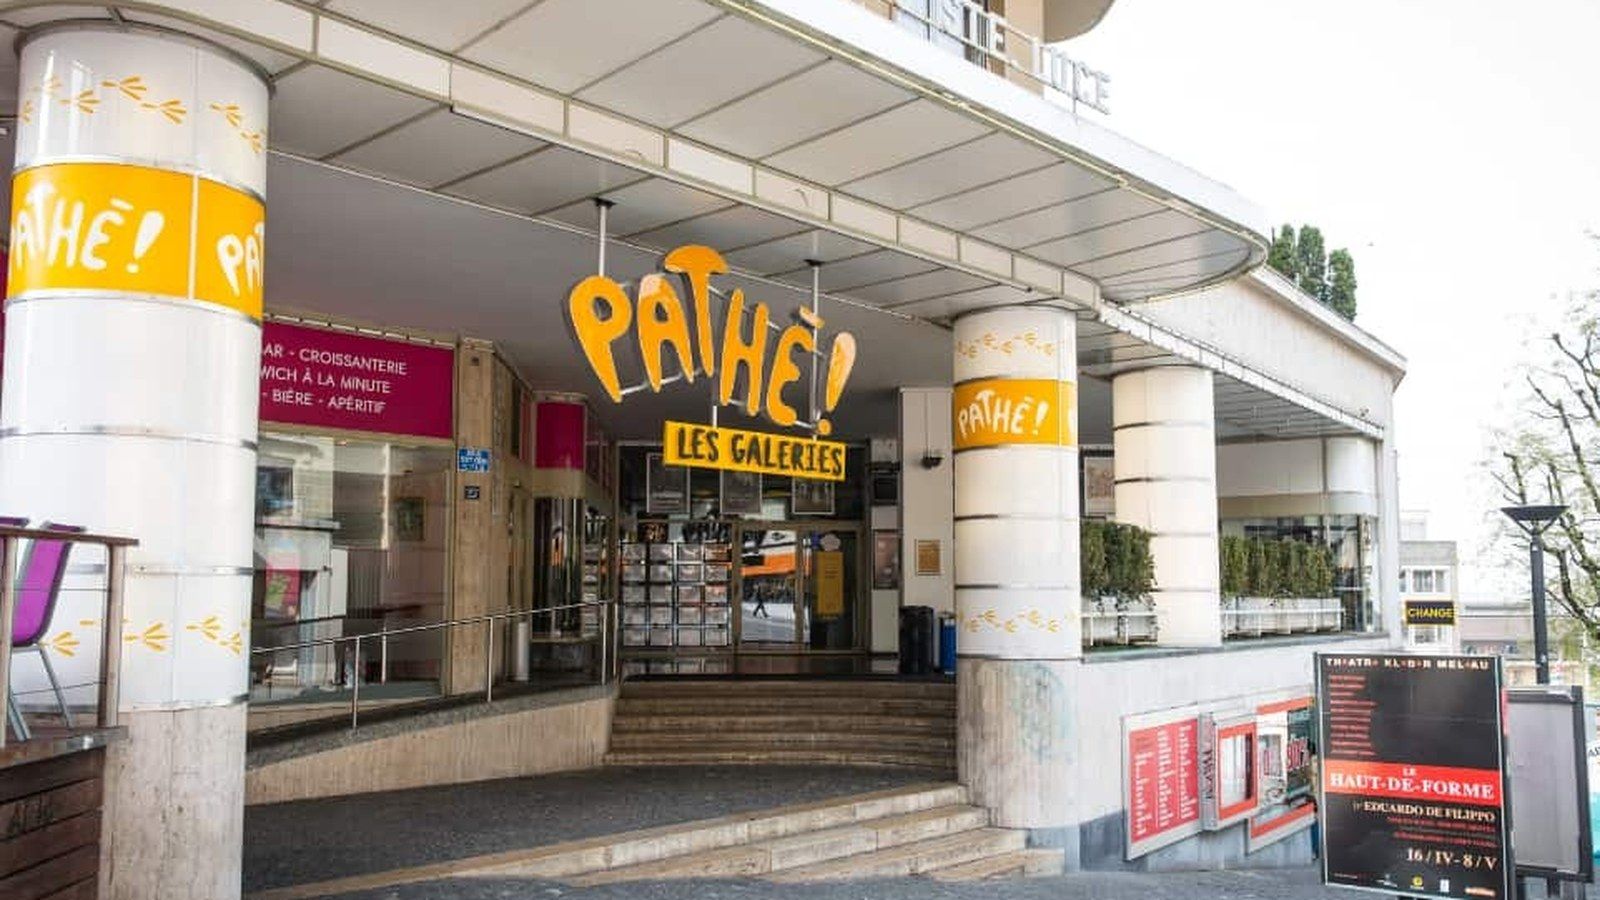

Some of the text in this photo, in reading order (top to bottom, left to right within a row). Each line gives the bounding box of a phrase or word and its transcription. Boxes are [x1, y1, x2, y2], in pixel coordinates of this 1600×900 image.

[10, 181, 165, 275] ATHÉ!
[299, 347, 408, 376] CROISSANTERIE
[318, 372, 335, 388] LA
[340, 375, 391, 394] MINUTE
[327, 396, 386, 414] APÉRITIF
[677, 426, 843, 477] LES GALERIES
[1408, 606, 1454, 618] CHANGE
[1329, 772, 1495, 799] HAUT-DE-FORME
[1426, 806, 1443, 818] DE
[1445, 808, 1496, 823] FILIPPO
